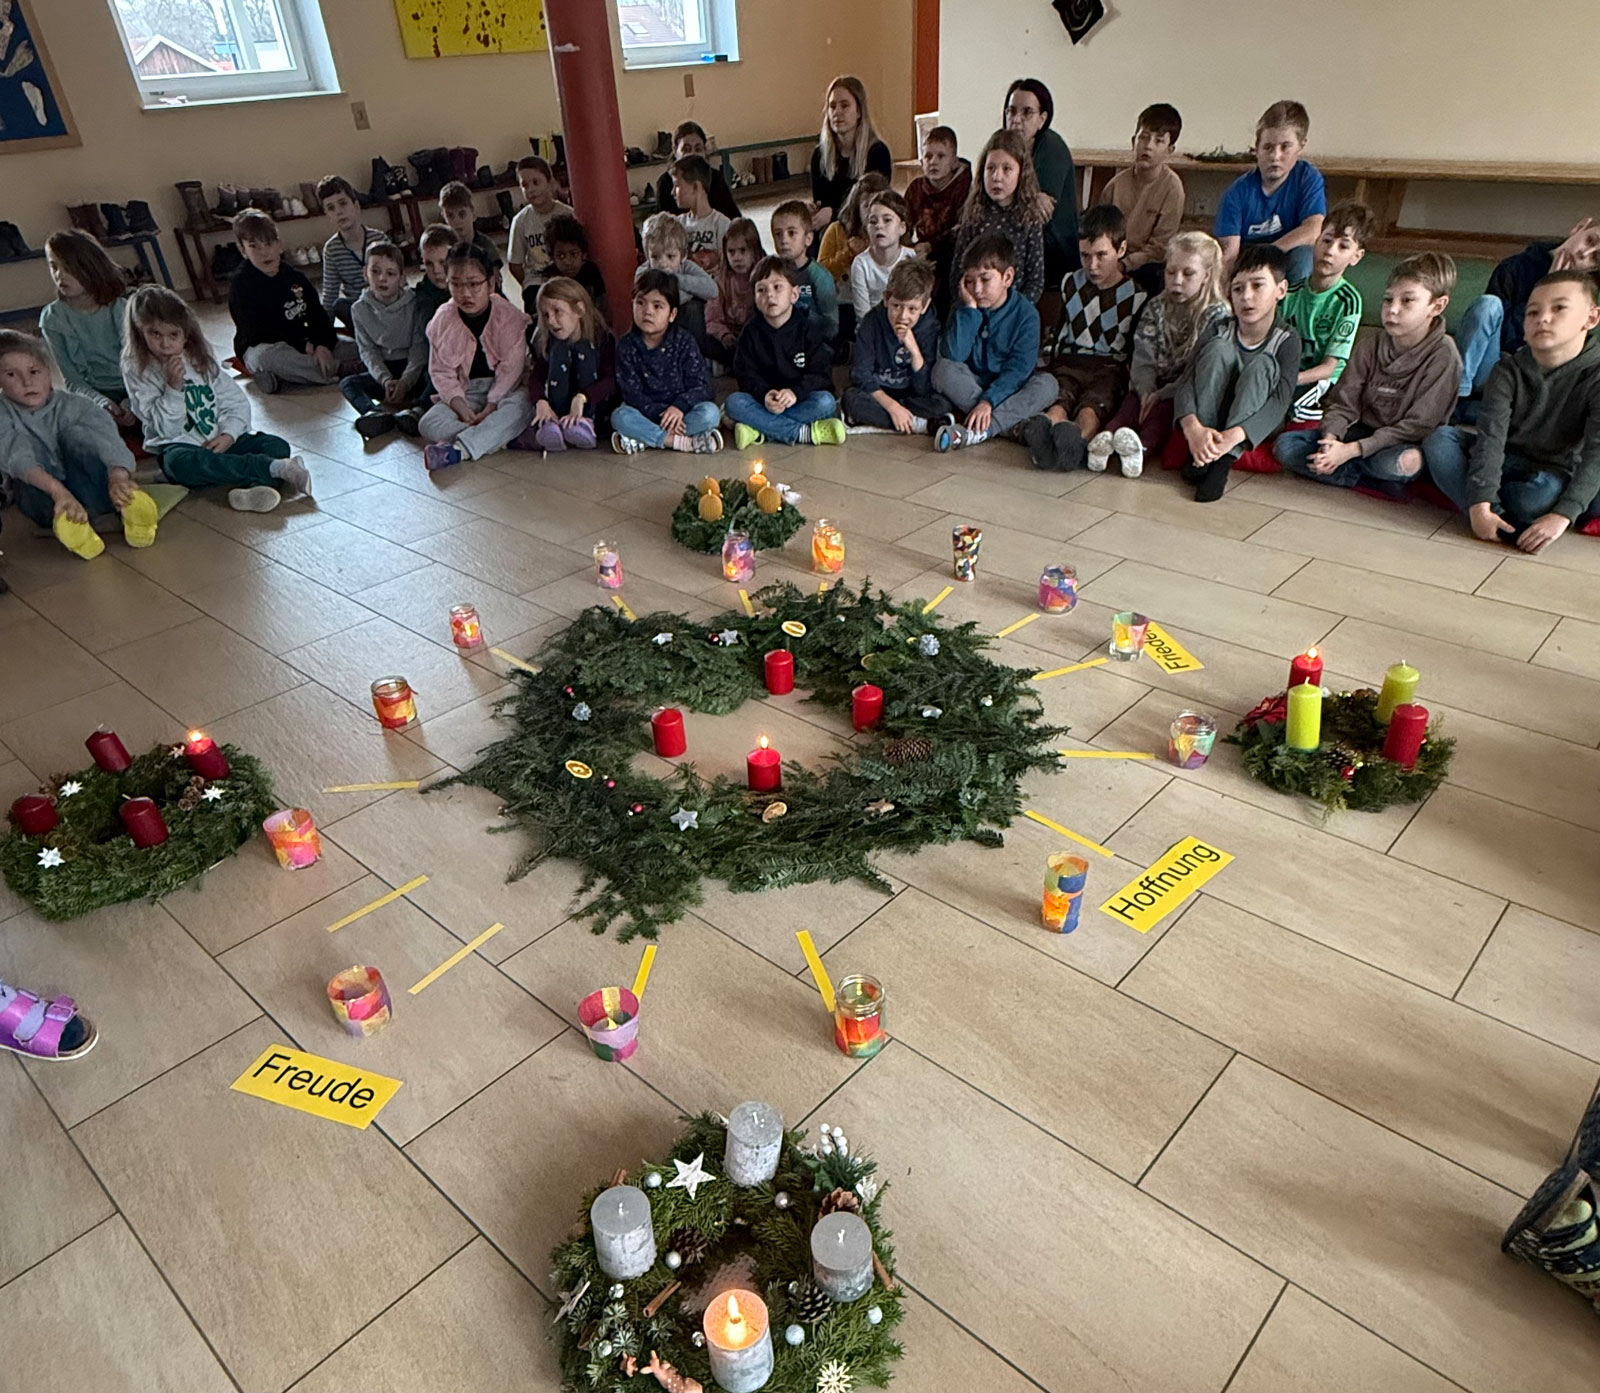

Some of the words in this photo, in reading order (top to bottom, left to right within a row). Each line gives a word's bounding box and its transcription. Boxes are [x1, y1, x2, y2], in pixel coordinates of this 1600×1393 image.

[1144, 629, 1190, 670] Friede
[1108, 844, 1221, 921] Hoffnung
[252, 1053, 375, 1109] Freude
